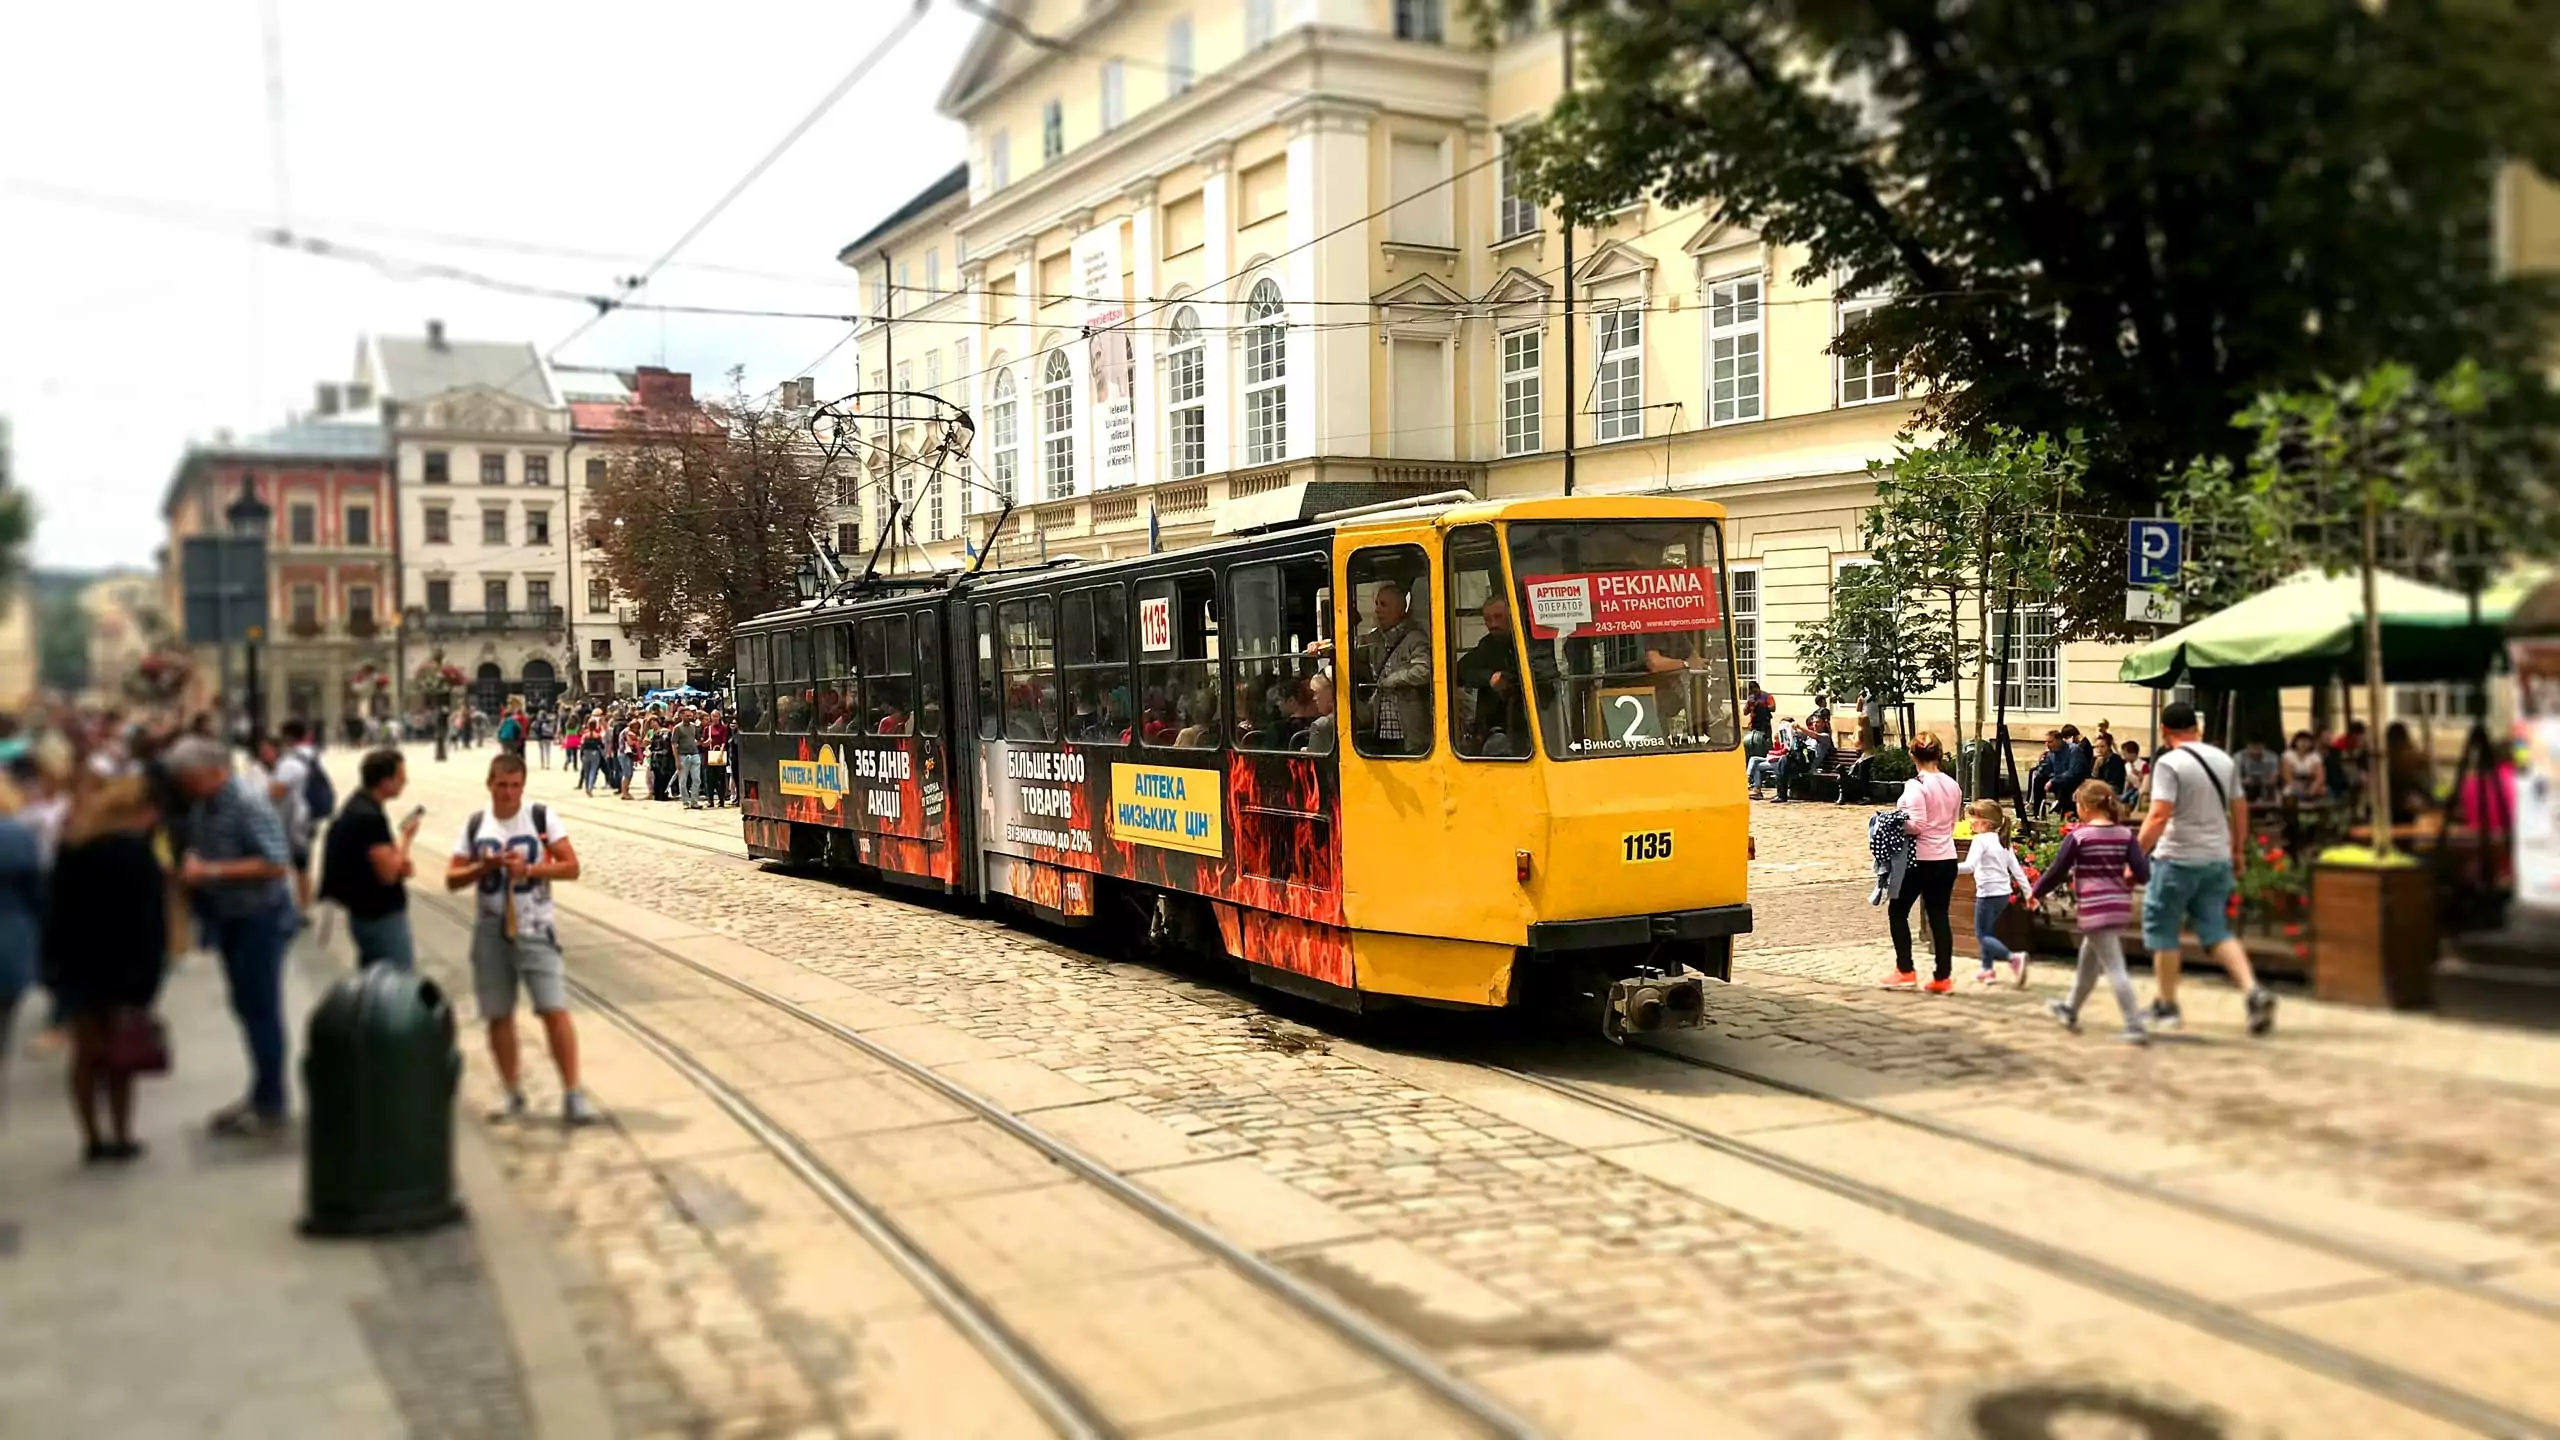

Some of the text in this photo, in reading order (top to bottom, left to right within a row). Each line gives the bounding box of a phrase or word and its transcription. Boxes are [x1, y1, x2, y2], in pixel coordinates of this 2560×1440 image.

[2141, 526, 2169, 577] P
[1536, 585, 1581, 598] АРТПРОМ
[1597, 573, 1702, 596] РЕКЛАМА
[1538, 601, 1583, 612] ОПЕРАТОР
[1600, 595, 1705, 612] НА ТРАНСПОРТІ
[1143, 604, 1167, 645] 1135
[1595, 620, 1641, 632] 243-78-00
[1614, 695, 1644, 741] 2
[1583, 734, 1697, 750] Винос кузова 1,7 м
[782, 766, 813, 785] АПТЕКА
[854, 748, 911, 783] 365 ДНІВ
[1008, 751, 1085, 783] БІЛЬШЕ 5000
[1135, 773, 1186, 800] АПТЕКА
[867, 784, 900, 823] АКЦІЇ
[1021, 786, 1072, 819] ТОВАРІВ
[1118, 803, 1209, 841] НИЗЬКИХ ЦІН
[1071, 828, 1093, 854] 20%
[1623, 832, 1672, 861] 1135
